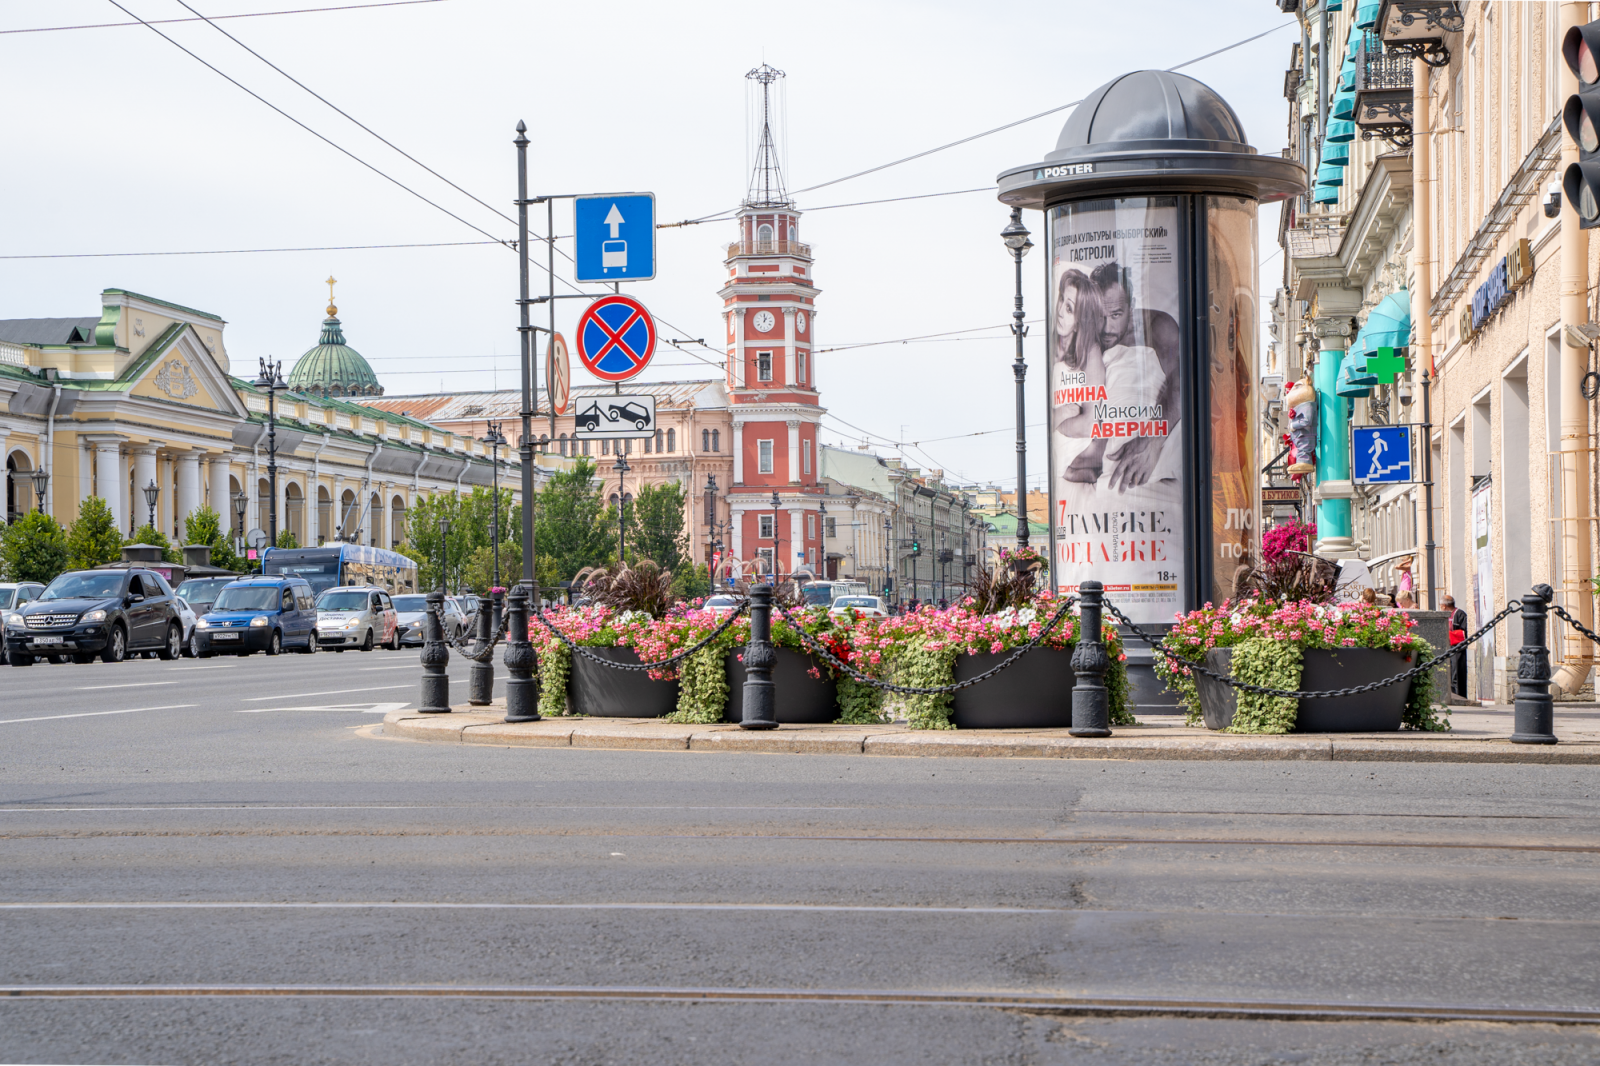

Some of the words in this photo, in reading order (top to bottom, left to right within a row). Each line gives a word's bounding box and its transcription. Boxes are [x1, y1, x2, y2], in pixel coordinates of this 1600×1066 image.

[1044, 163, 1093, 178] POSTER
[1061, 234, 1078, 246] ДВОРЦА
[1078, 230, 1111, 243] КУЛЬТУРЫ
[1113, 226, 1168, 239] «ВЫБОРГСКИЙ»
[1070, 245, 1115, 262] ГАСТРОЛИ
[1060, 371, 1086, 386] Анна
[1094, 403, 1162, 420] Максим
[1091, 419, 1169, 438] АВЕРИН
[1267, 490, 1300, 500] БУТИКОВ
[1067, 512, 1108, 535] ТАМ
[1120, 511, 1172, 536] ЖЕ,
[1224, 508, 1255, 530] ЛЮ
[1057, 541, 1110, 567] ТОГДА
[1120, 540, 1167, 562] ЖЕ
[1157, 571, 1177, 581] 18+
